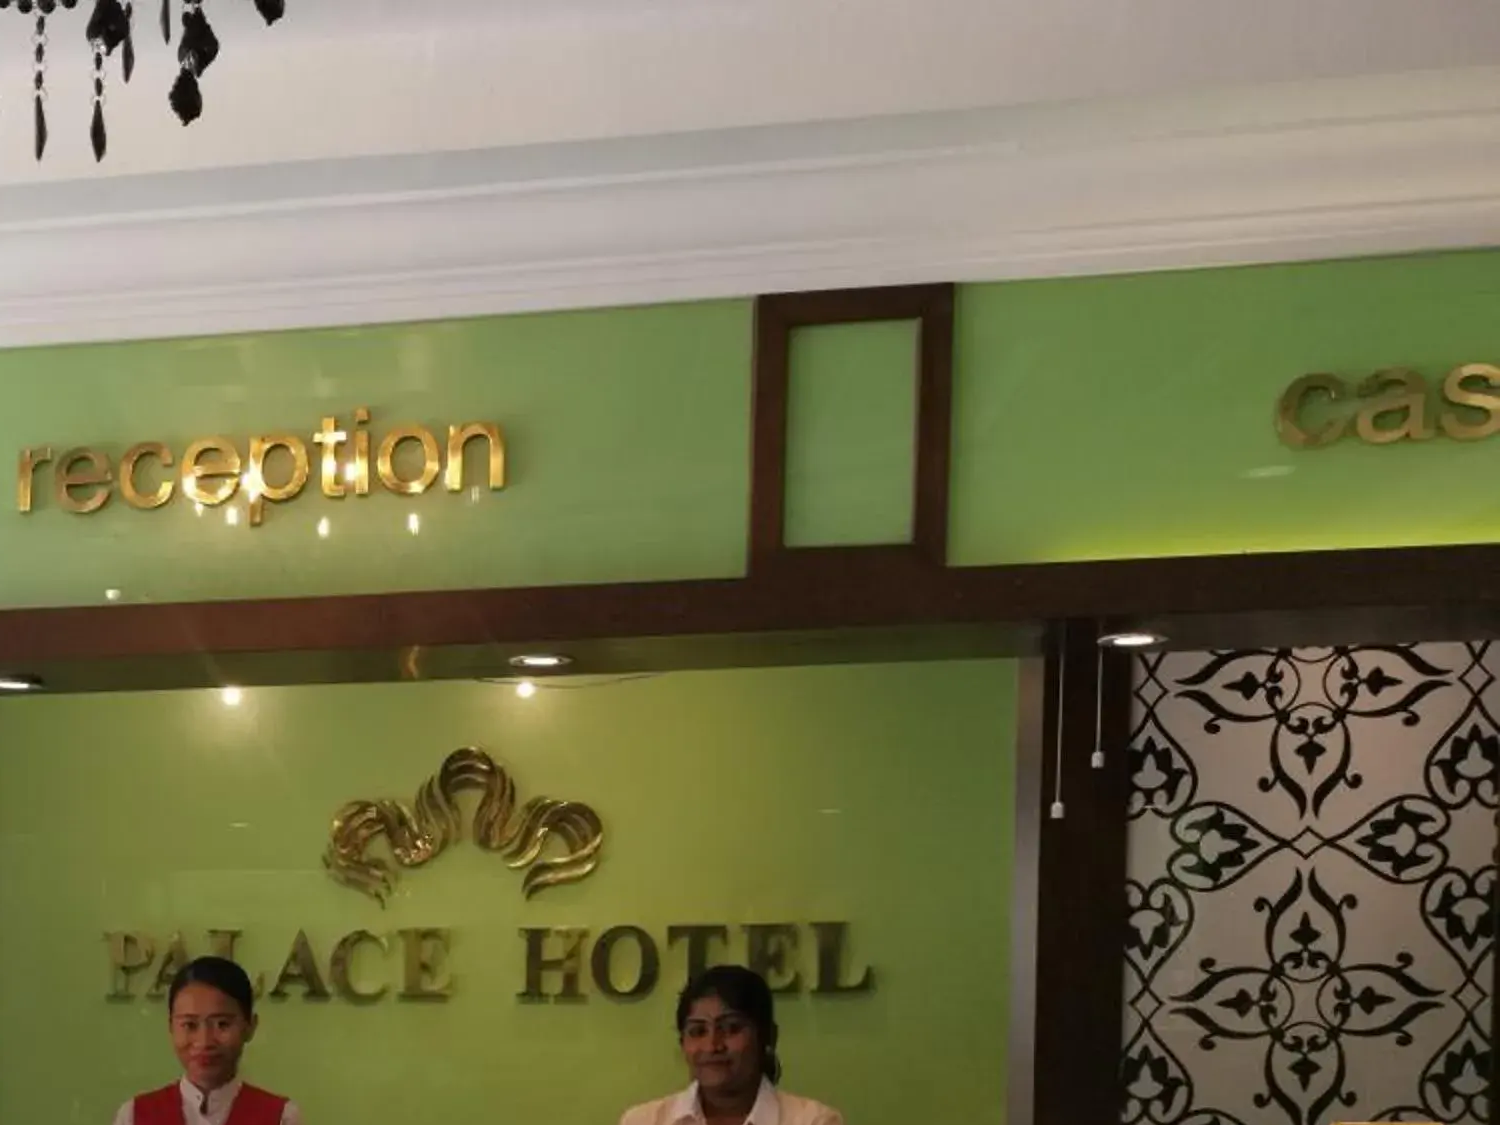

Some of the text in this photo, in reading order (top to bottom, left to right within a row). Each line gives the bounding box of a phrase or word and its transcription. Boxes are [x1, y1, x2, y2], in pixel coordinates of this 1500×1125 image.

[1273, 362, 1500, 450] cas
[16, 406, 508, 528] reception
[514, 920, 876, 1004] HOTEL
